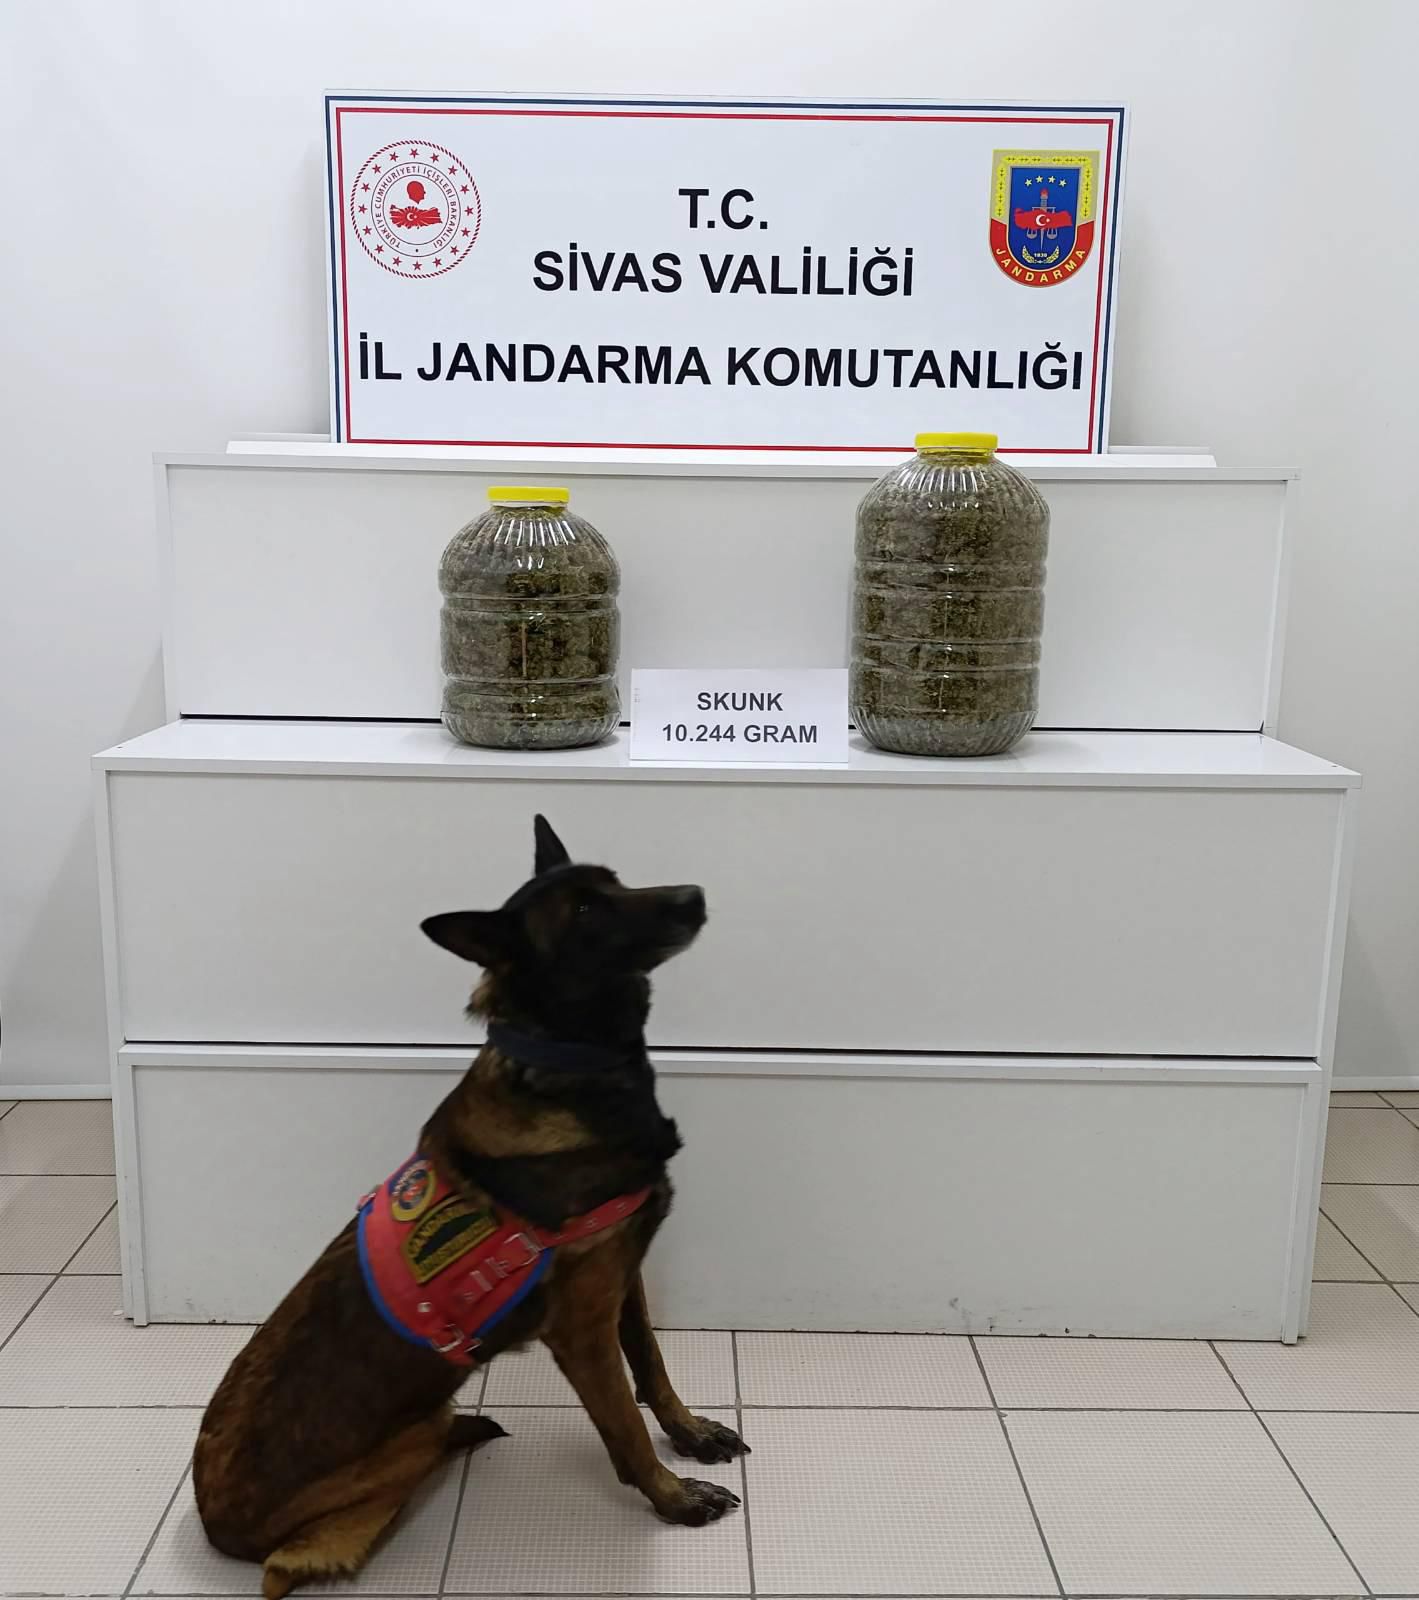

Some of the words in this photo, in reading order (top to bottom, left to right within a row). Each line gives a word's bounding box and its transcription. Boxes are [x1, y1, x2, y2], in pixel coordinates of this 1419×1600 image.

[375, 166, 420, 209] CUMHURİYETİ
[433, 200, 457, 249] BAKANLIĞI
[679, 188, 768, 229] T.C.
[375, 212, 401, 249] TÜRKİYE
[533, 243, 681, 293] SİVAS
[699, 246, 914, 296] VALİLİĞİ
[996, 248, 1086, 283] JANDARMA
[359, 332, 402, 380] İL
[417, 342, 711, 385] JANDARMA
[728, 342, 1083, 390] KOMUTANLIĞI
[697, 692, 783, 711] SKUNK
[662, 724, 736, 742] 10.244
[743, 724, 817, 743] GRAM
